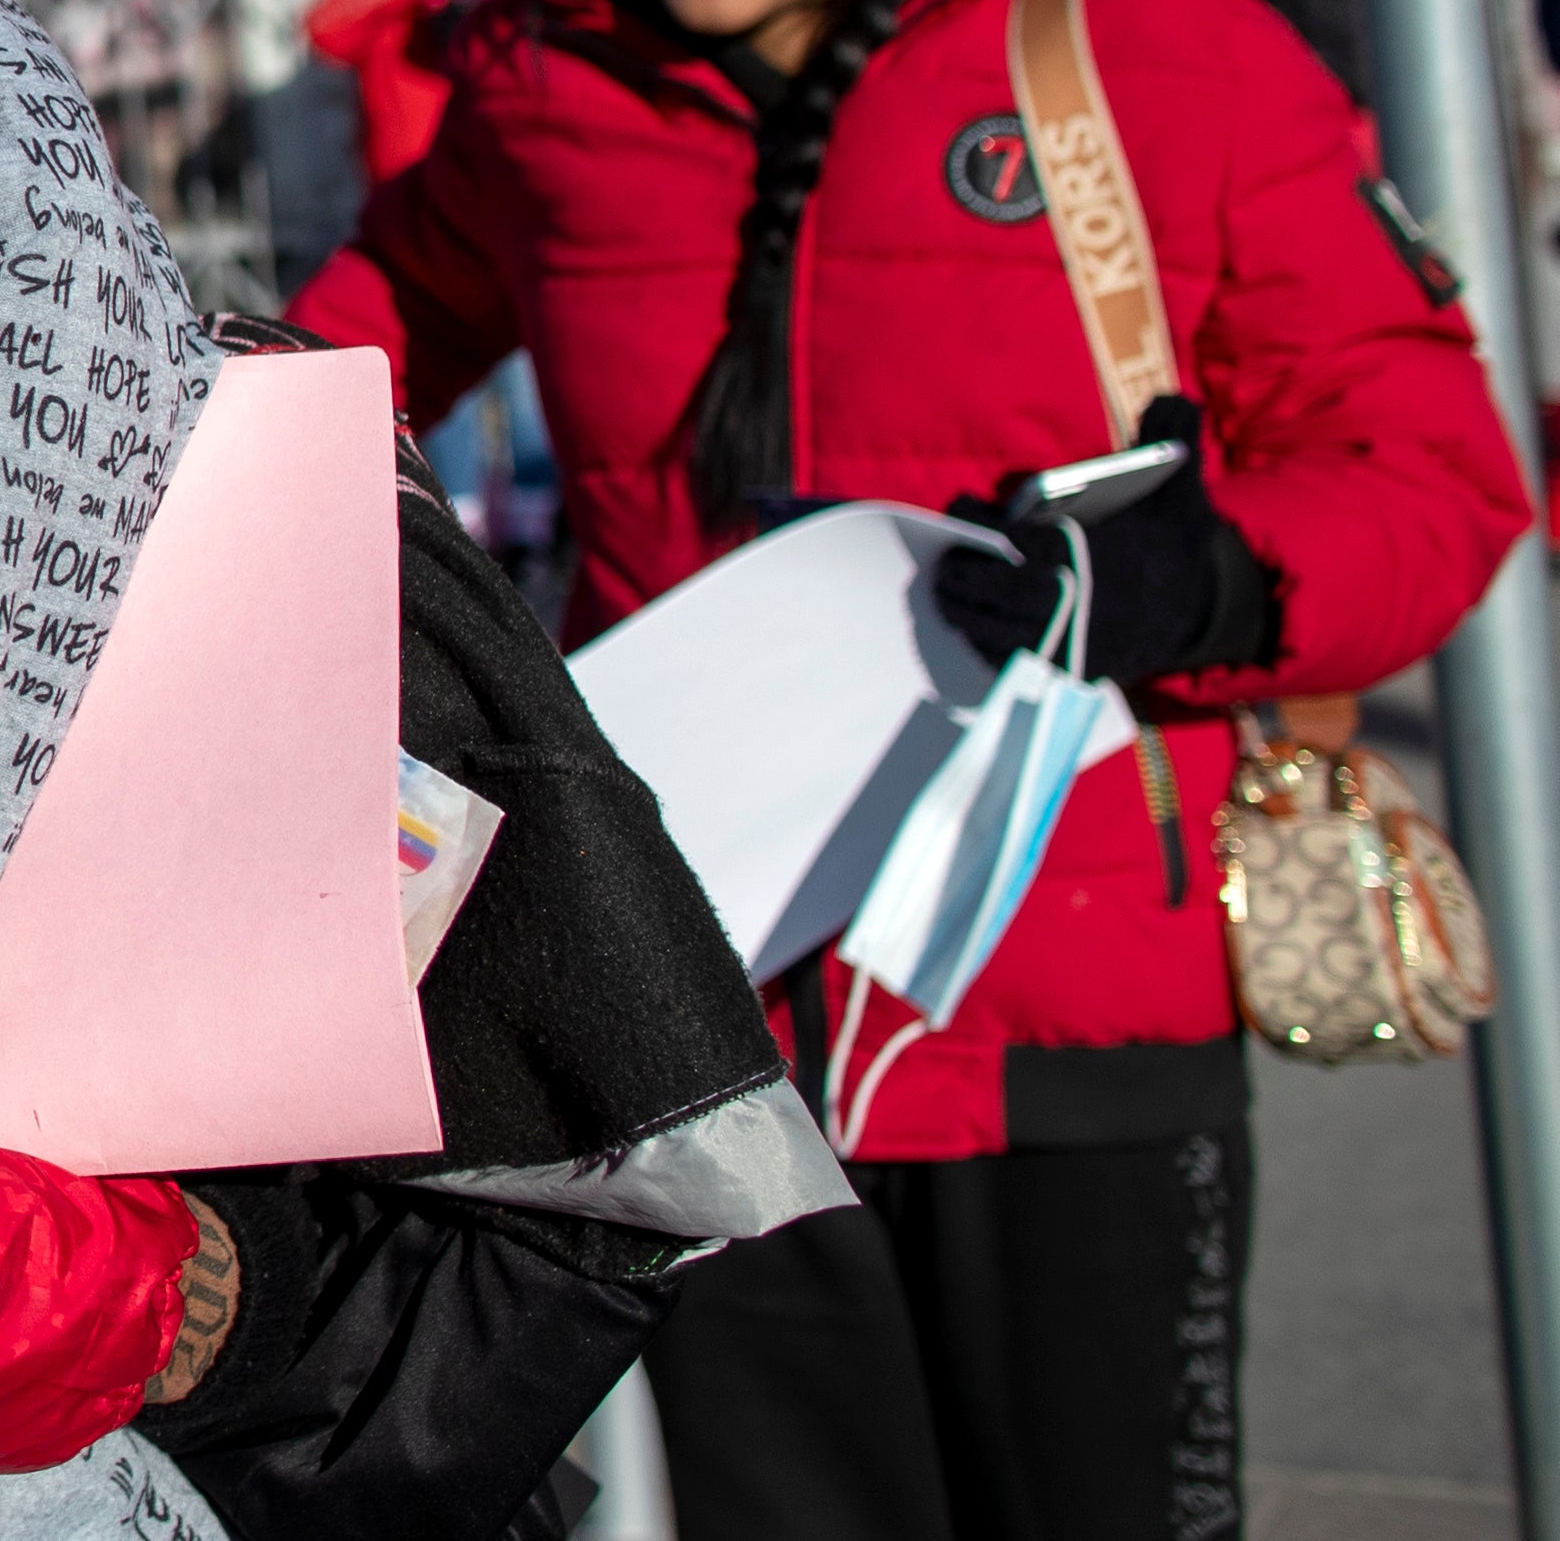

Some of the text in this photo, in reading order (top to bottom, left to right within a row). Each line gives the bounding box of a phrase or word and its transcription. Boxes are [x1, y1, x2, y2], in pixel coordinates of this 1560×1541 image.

[18, 137, 105, 190] YOU
[24, 185, 107, 250] belong
[1041, 114, 1139, 298] KORS
[87, 345, 151, 413] HOPE
[9, 382, 88, 459] YOU
[32, 527, 122, 602] YOUR
